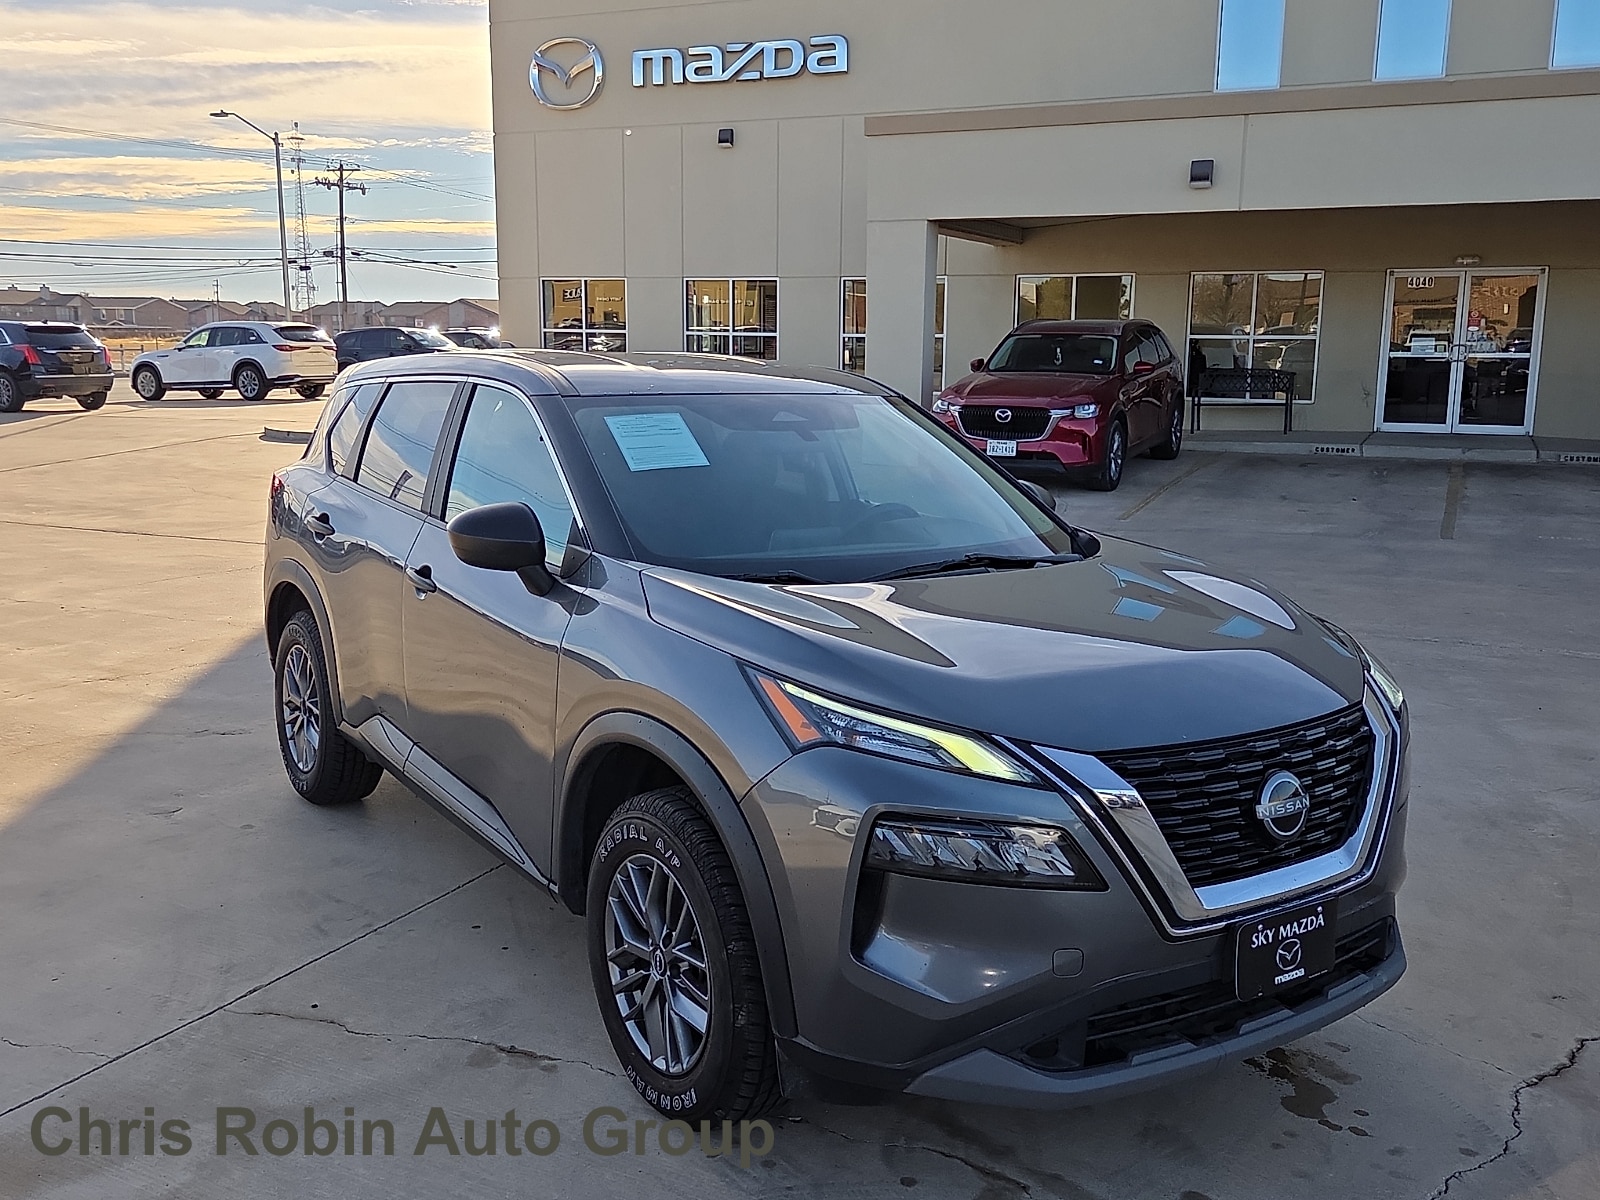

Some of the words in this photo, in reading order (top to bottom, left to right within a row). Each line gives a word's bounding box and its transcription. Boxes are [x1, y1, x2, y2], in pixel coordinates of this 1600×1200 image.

[1408, 276, 1433, 287] 4040
[1258, 793, 1309, 817] NISSAN
[599, 824, 648, 862] RADIAL
[655, 837, 681, 868] A/P
[1251, 927, 1275, 949] SKY
[1279, 913, 1325, 940] MAZDA
